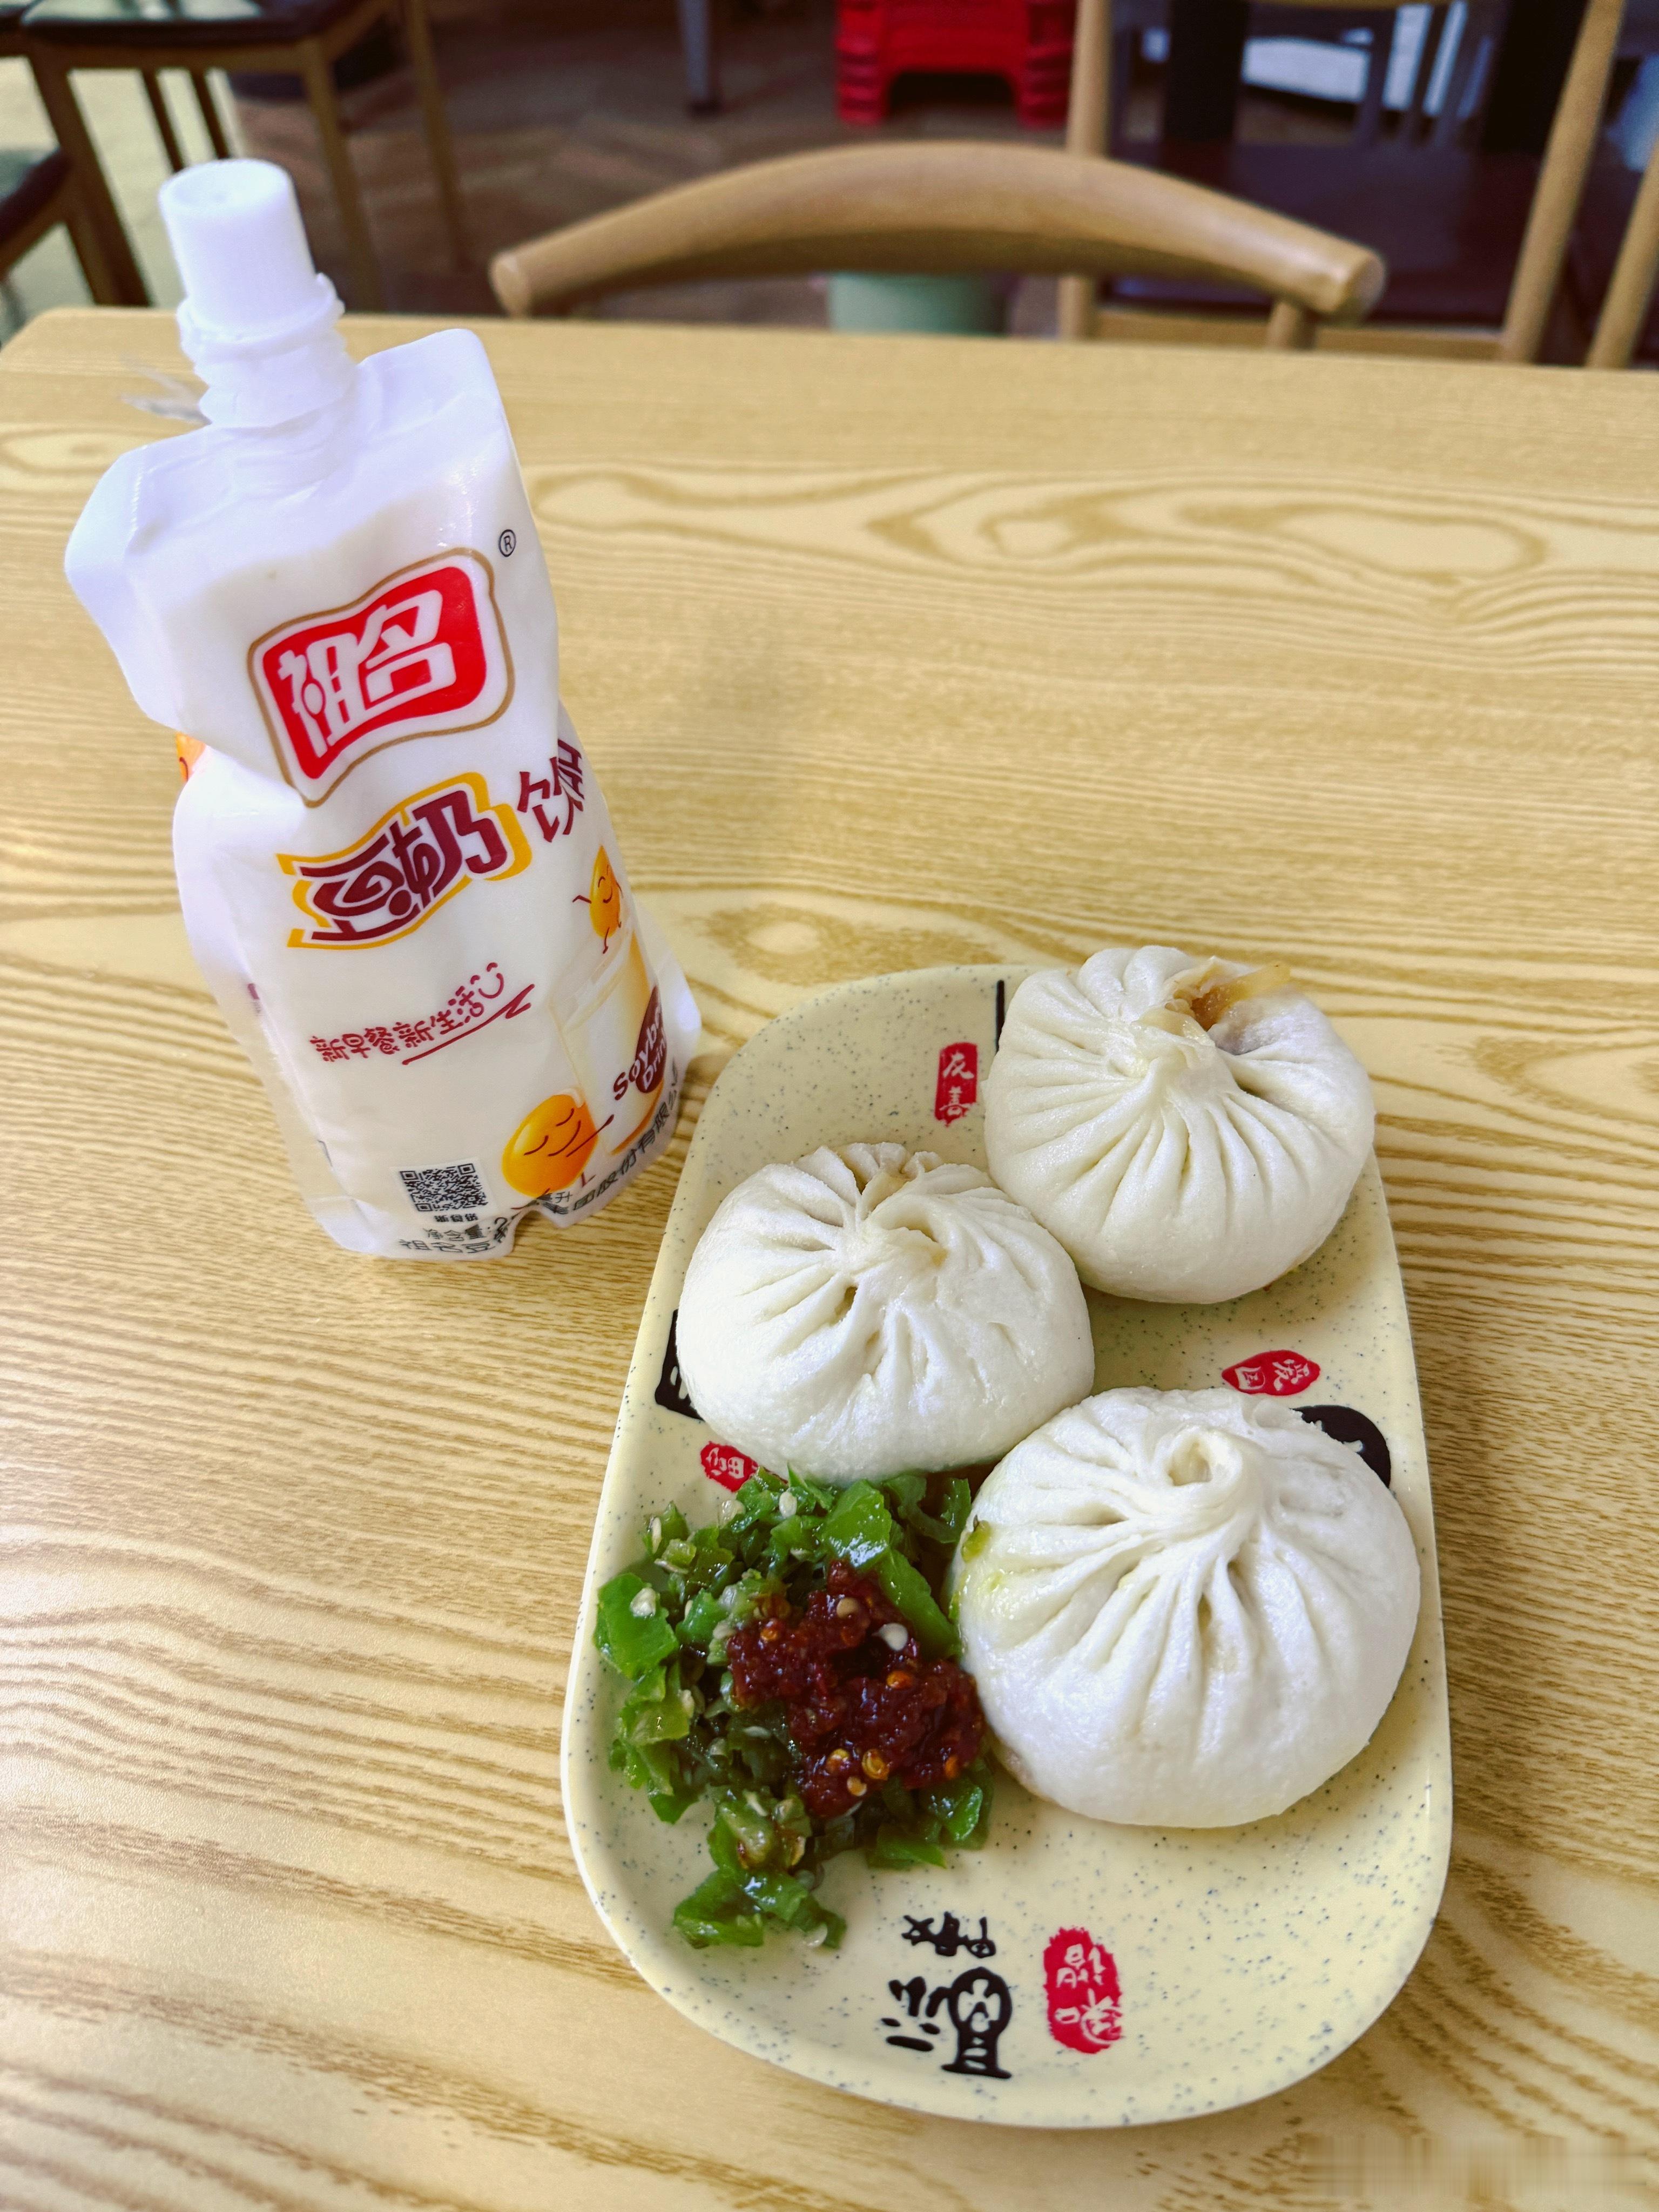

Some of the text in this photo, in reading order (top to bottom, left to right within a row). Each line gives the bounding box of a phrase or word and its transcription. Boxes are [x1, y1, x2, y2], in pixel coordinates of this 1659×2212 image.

[278, 588, 456, 758] 祖名
[310, 986, 485, 1062] 新早餐新生活
[1234, 1358, 1310, 1392] 爱国
[1054, 1944, 1123, 2045] 和谐
